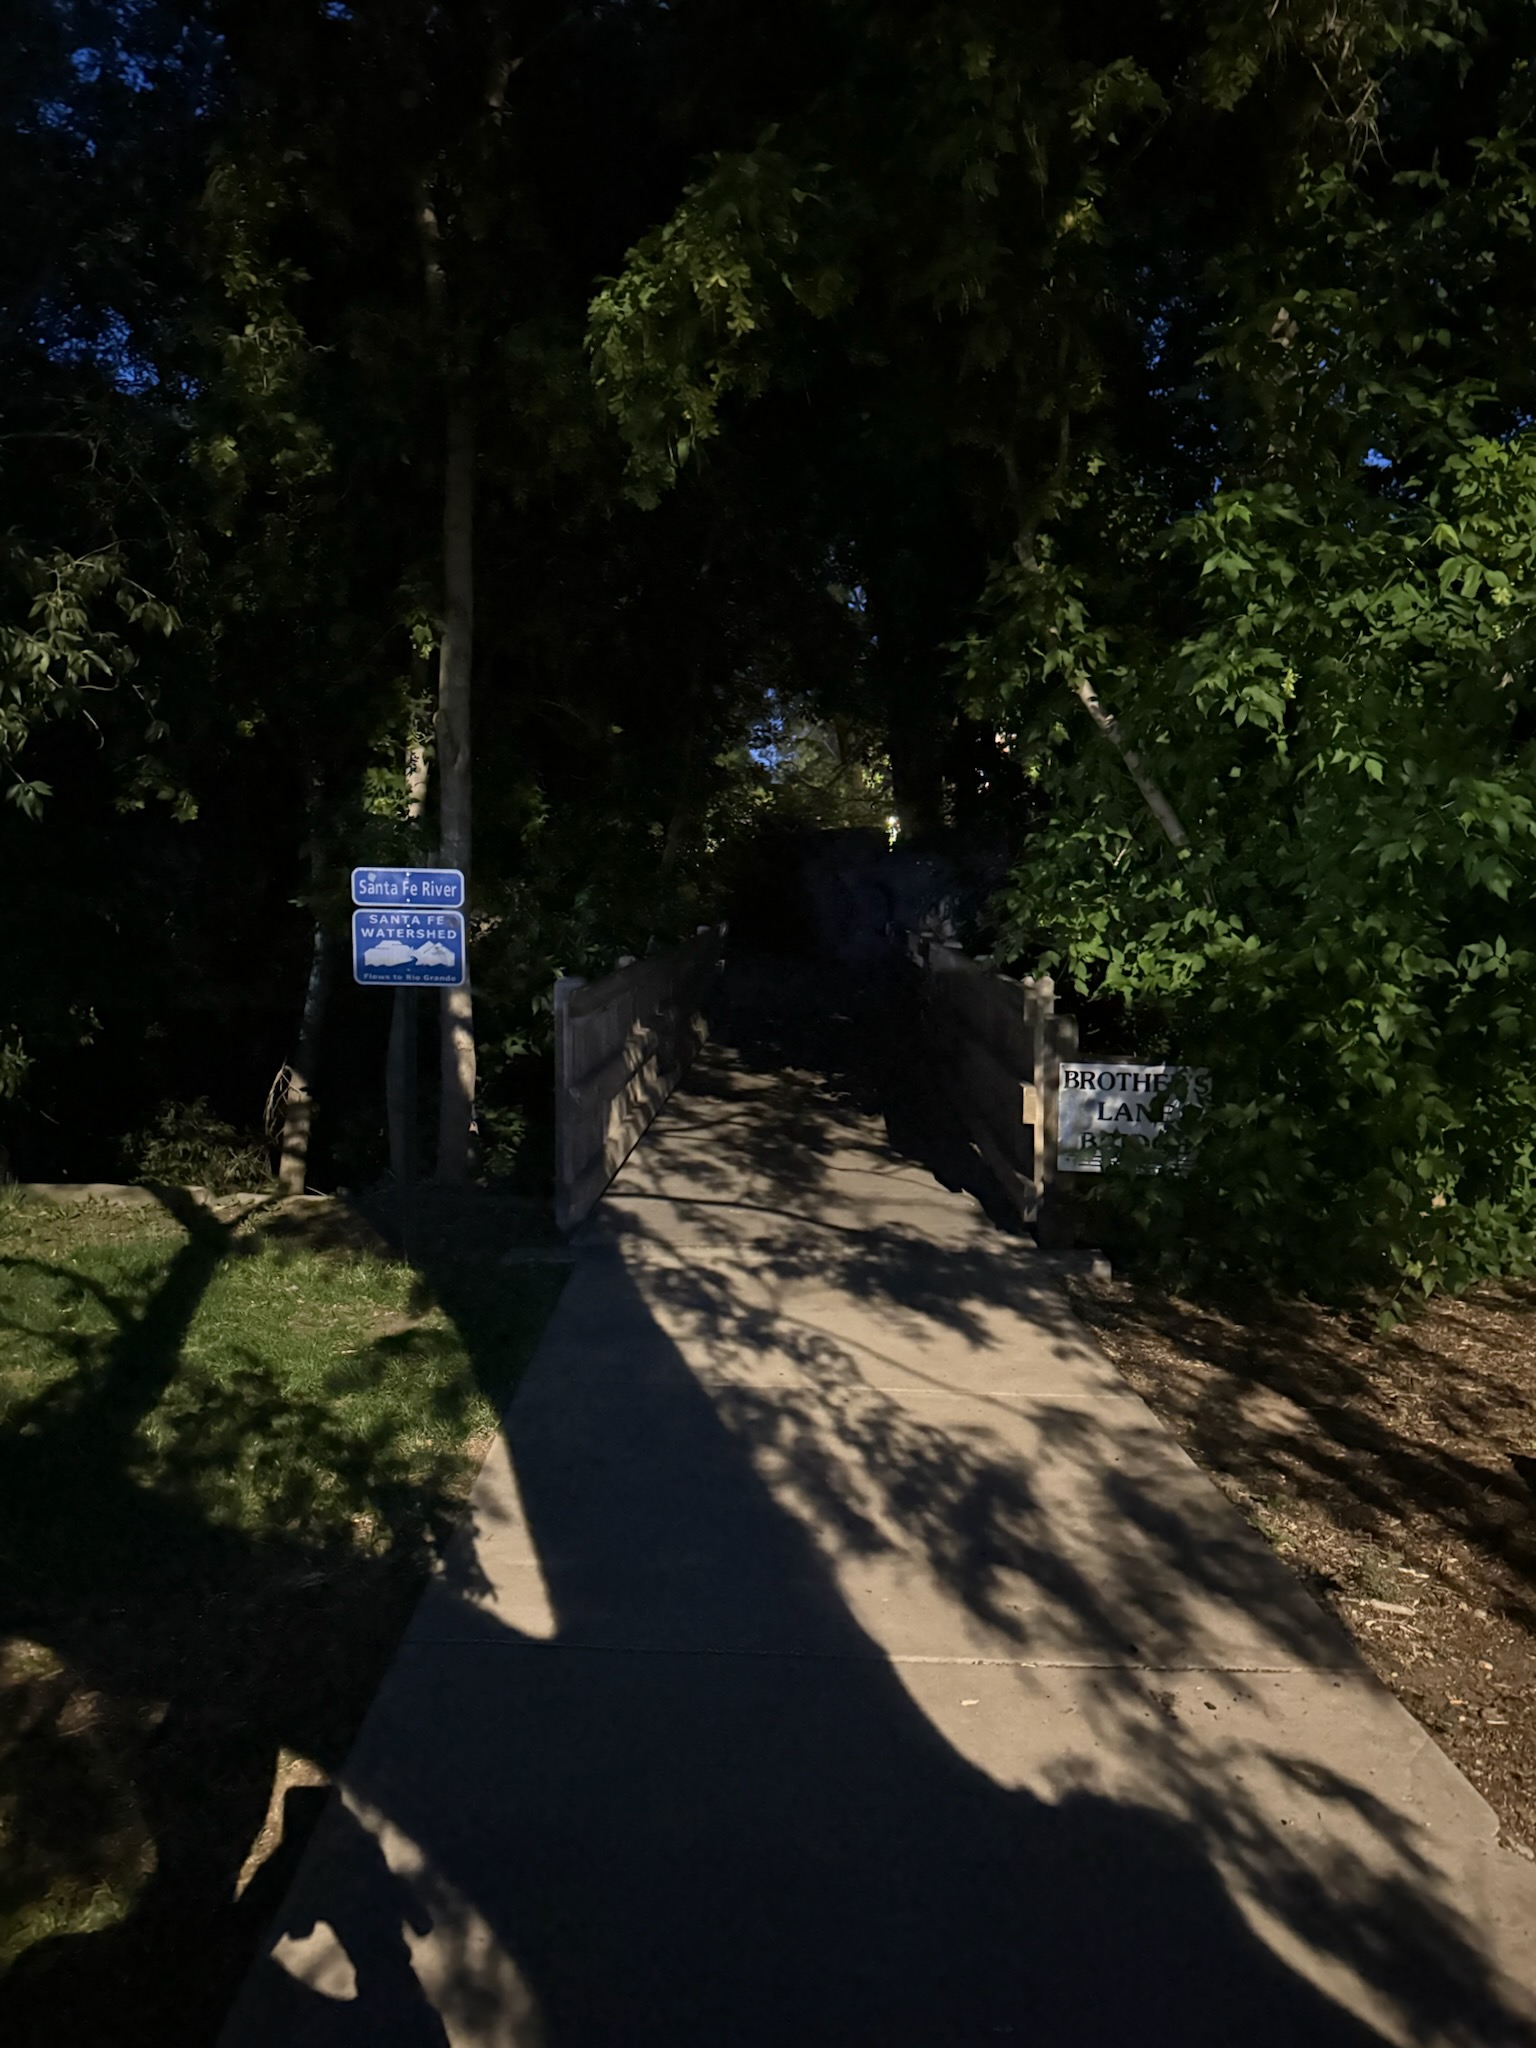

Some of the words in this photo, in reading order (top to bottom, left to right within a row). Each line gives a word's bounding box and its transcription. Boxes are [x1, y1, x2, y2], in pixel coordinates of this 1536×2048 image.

[359, 879, 398, 896] Santa
[402, 880, 418, 896] Fe
[422, 881, 457, 897] River
[369, 914, 420, 925] SANTA
[427, 915, 445, 925] FE
[360, 928, 457, 939] WATERSHED
[423, 974, 457, 982] Grande
[1063, 1070, 1209, 1095] BROTHES
